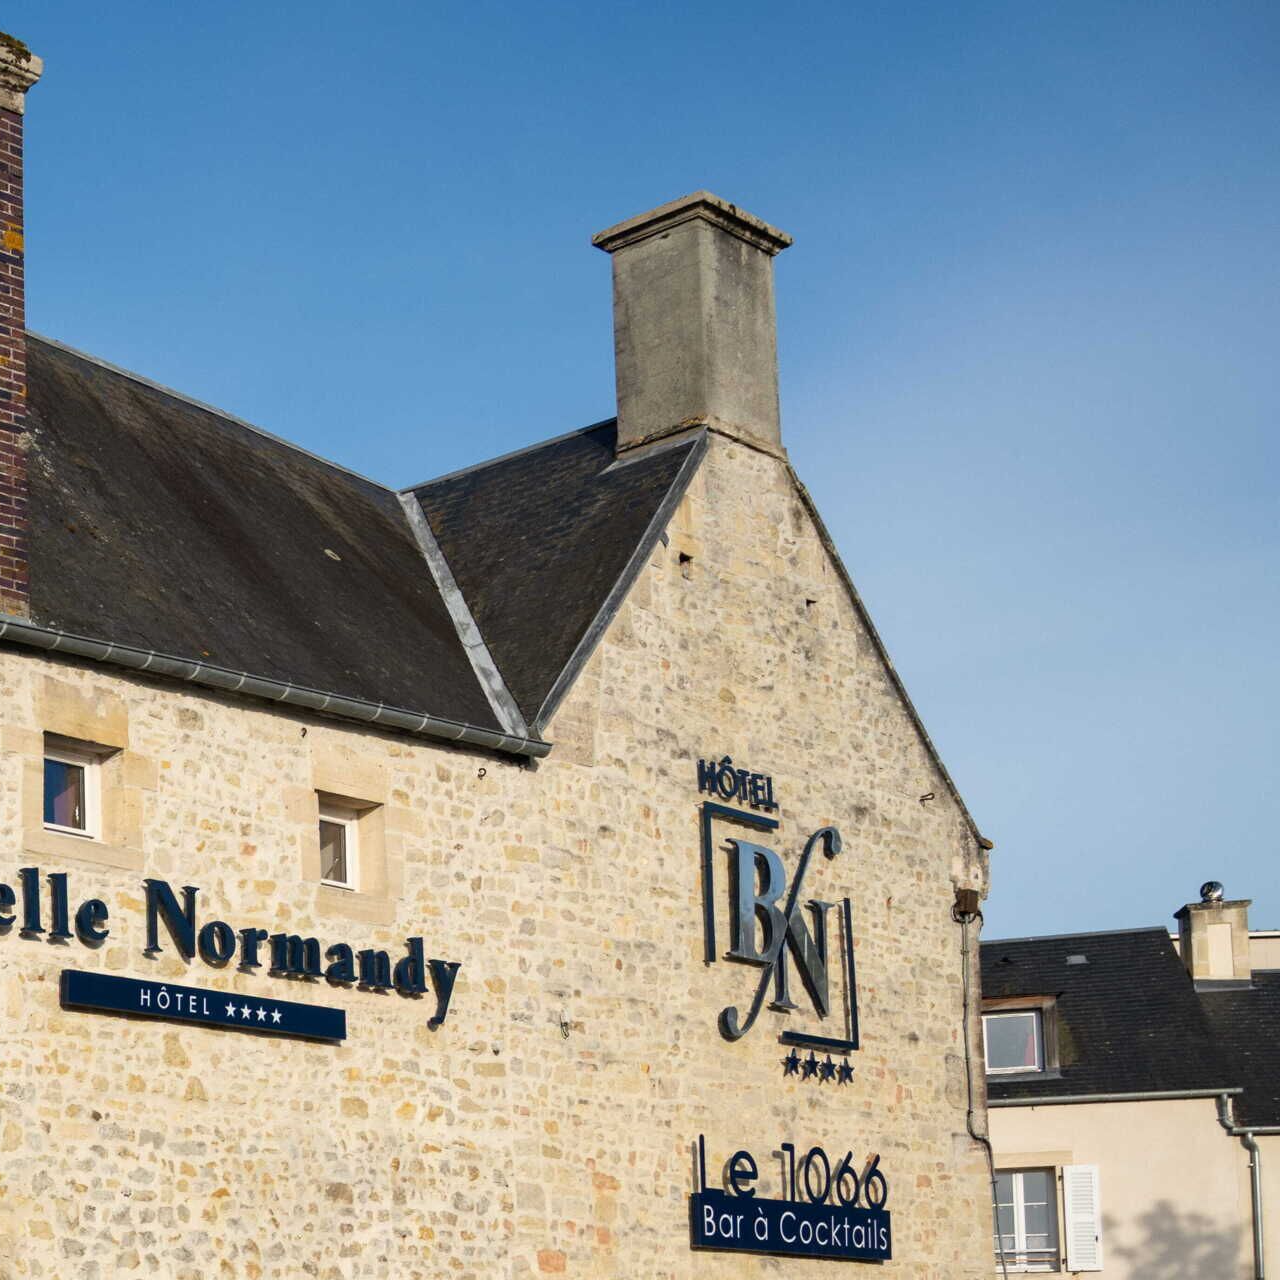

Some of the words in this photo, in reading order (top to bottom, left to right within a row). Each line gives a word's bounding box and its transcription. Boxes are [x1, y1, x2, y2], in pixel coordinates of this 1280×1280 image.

[698, 755, 778, 808] HÔTEL
[143, 878, 462, 1025] Normandy
[140, 986, 210, 1016] HÔTEL
[698, 1133, 758, 1197] Le
[781, 1142, 888, 1211] 1066
[703, 1204, 744, 1239] Bar
[754, 1207, 769, 1241] à
[779, 1211, 888, 1251] Cocktails
